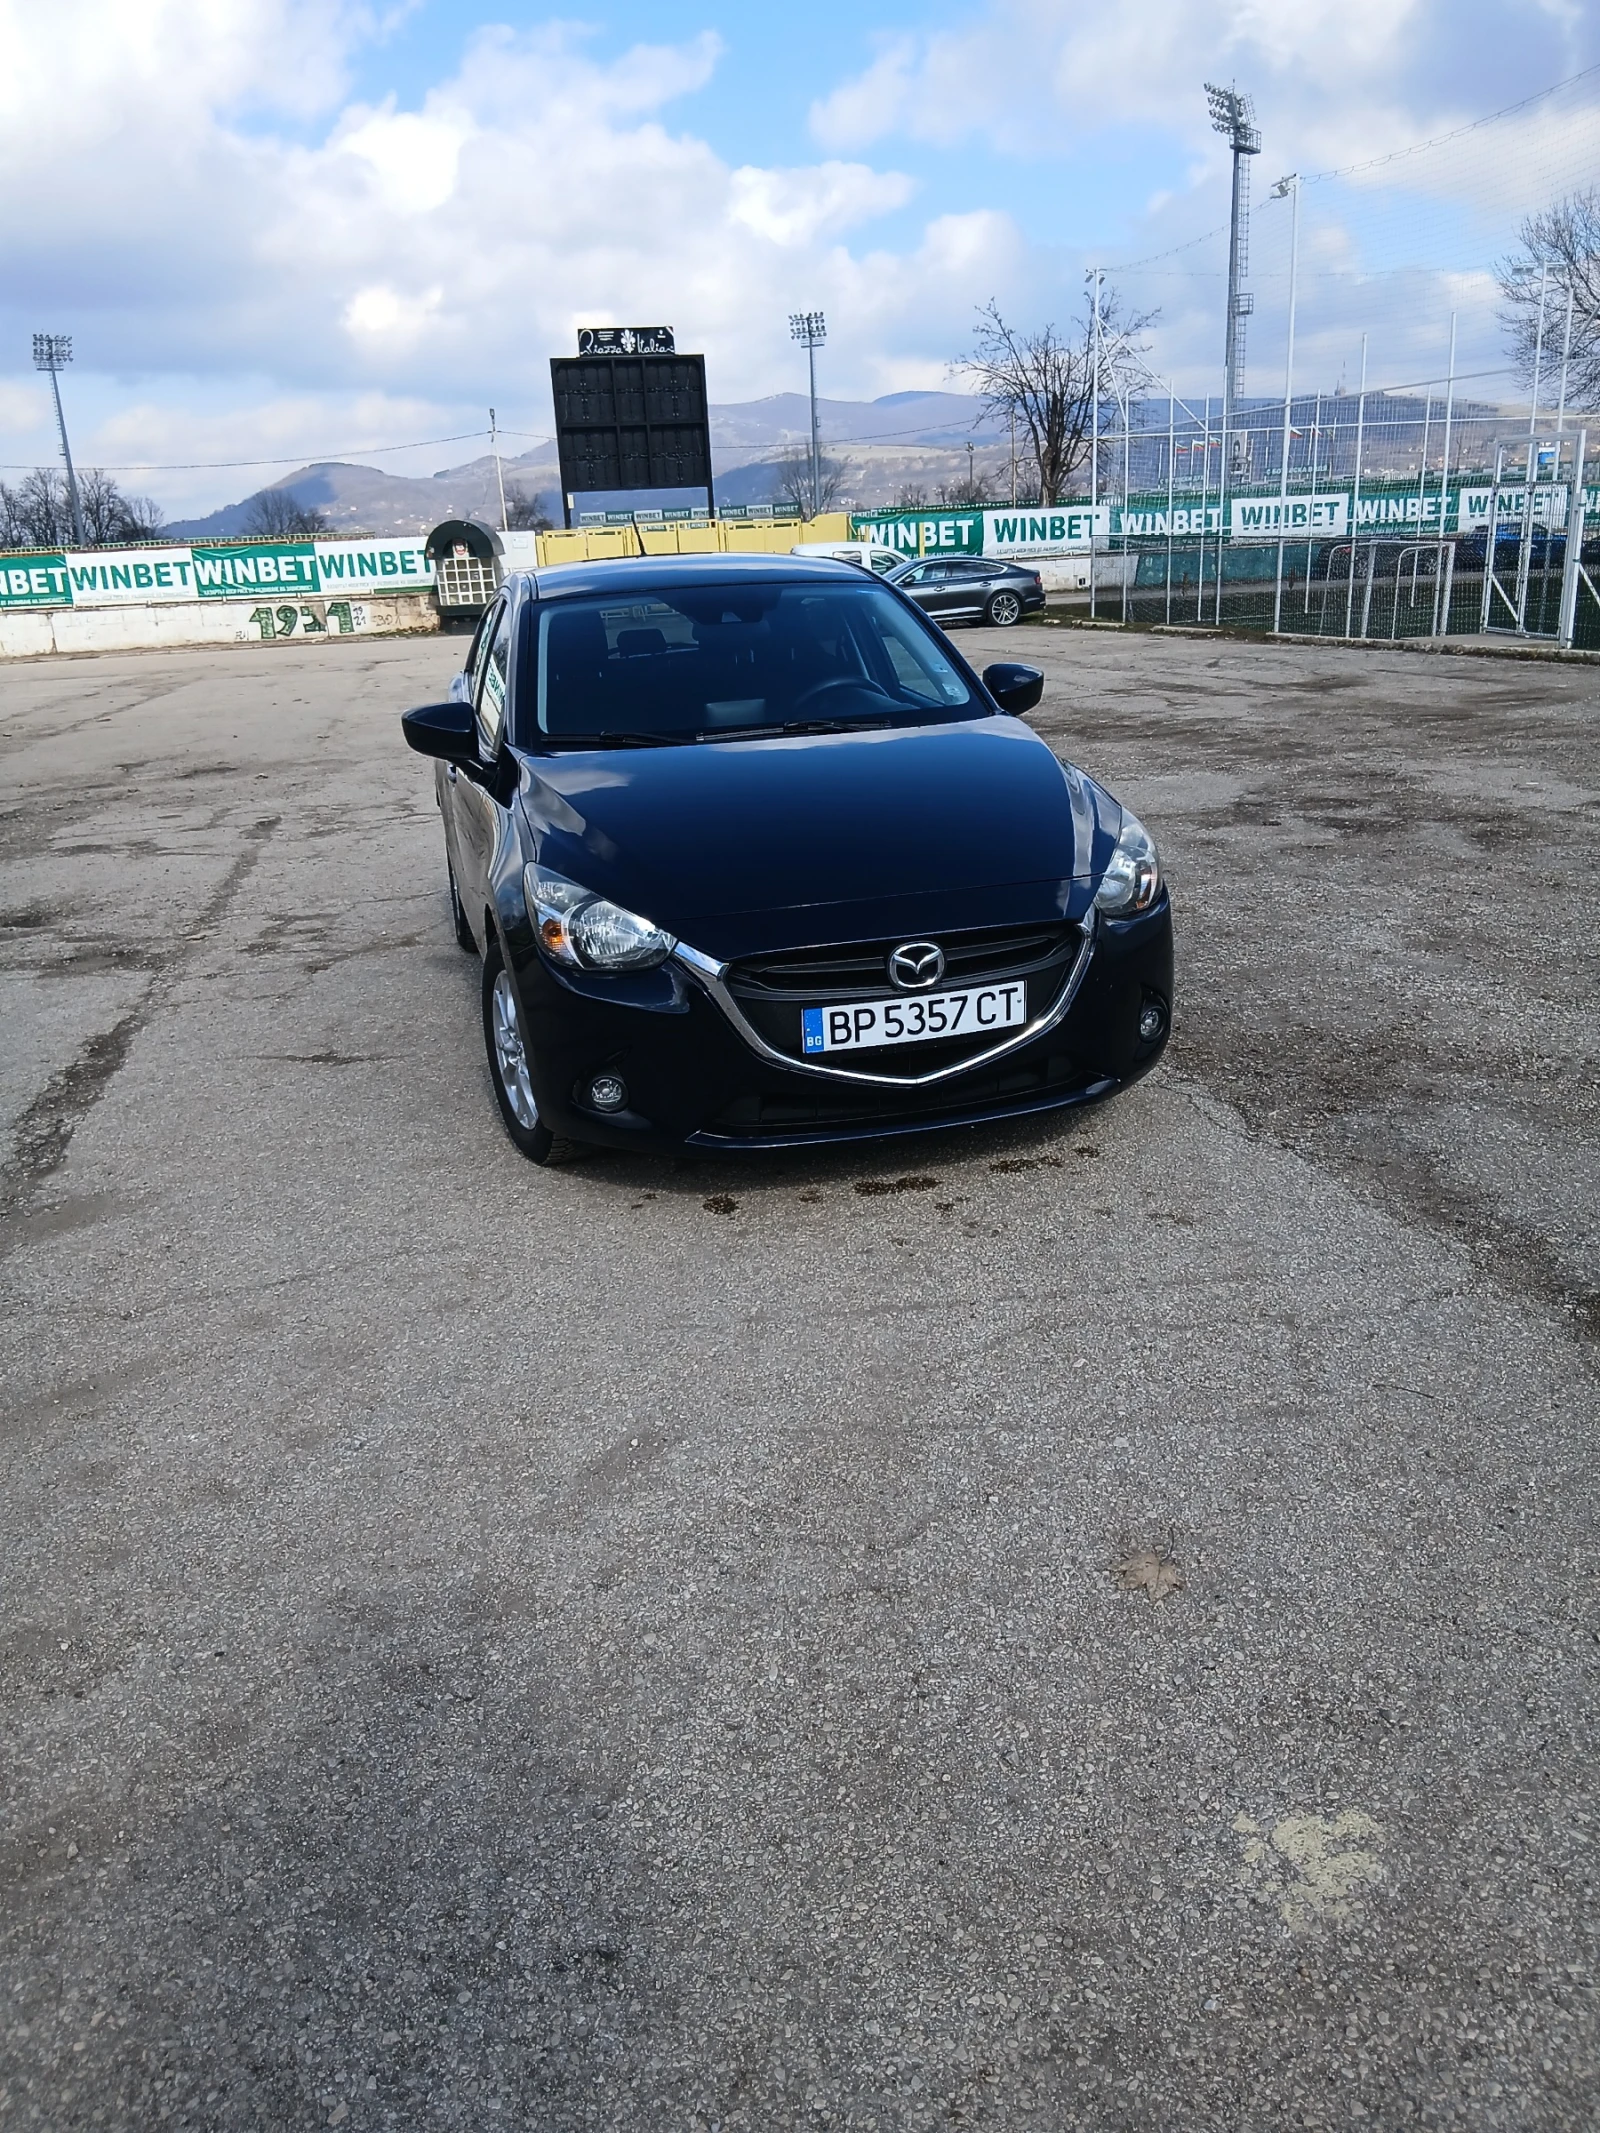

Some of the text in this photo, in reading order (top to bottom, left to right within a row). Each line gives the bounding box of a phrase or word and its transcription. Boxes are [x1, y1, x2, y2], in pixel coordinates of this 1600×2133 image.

[637, 333, 675, 354] Italia
[607, 513, 632, 521] WINBET
[636, 512, 660, 520] WINBET
[664, 510, 689, 518] WINBET
[722, 506, 746, 516] WINBET
[749, 505, 772, 514] WINBET
[775, 504, 799, 514] WINBET
[1120, 508, 1221, 536] WINBET
[1241, 502, 1340, 530] WINBET
[1356, 496, 1452, 525] WINBET
[860, 519, 974, 549] WINBET
[993, 514, 1100, 543] WINBET
[70, 561, 191, 591] WINBET
[193, 555, 315, 585] WINBET
[319, 550, 432, 579] WINBET
[829, 987, 1019, 1045] BP 5357 CT
[806, 1036, 822, 1047] BG
